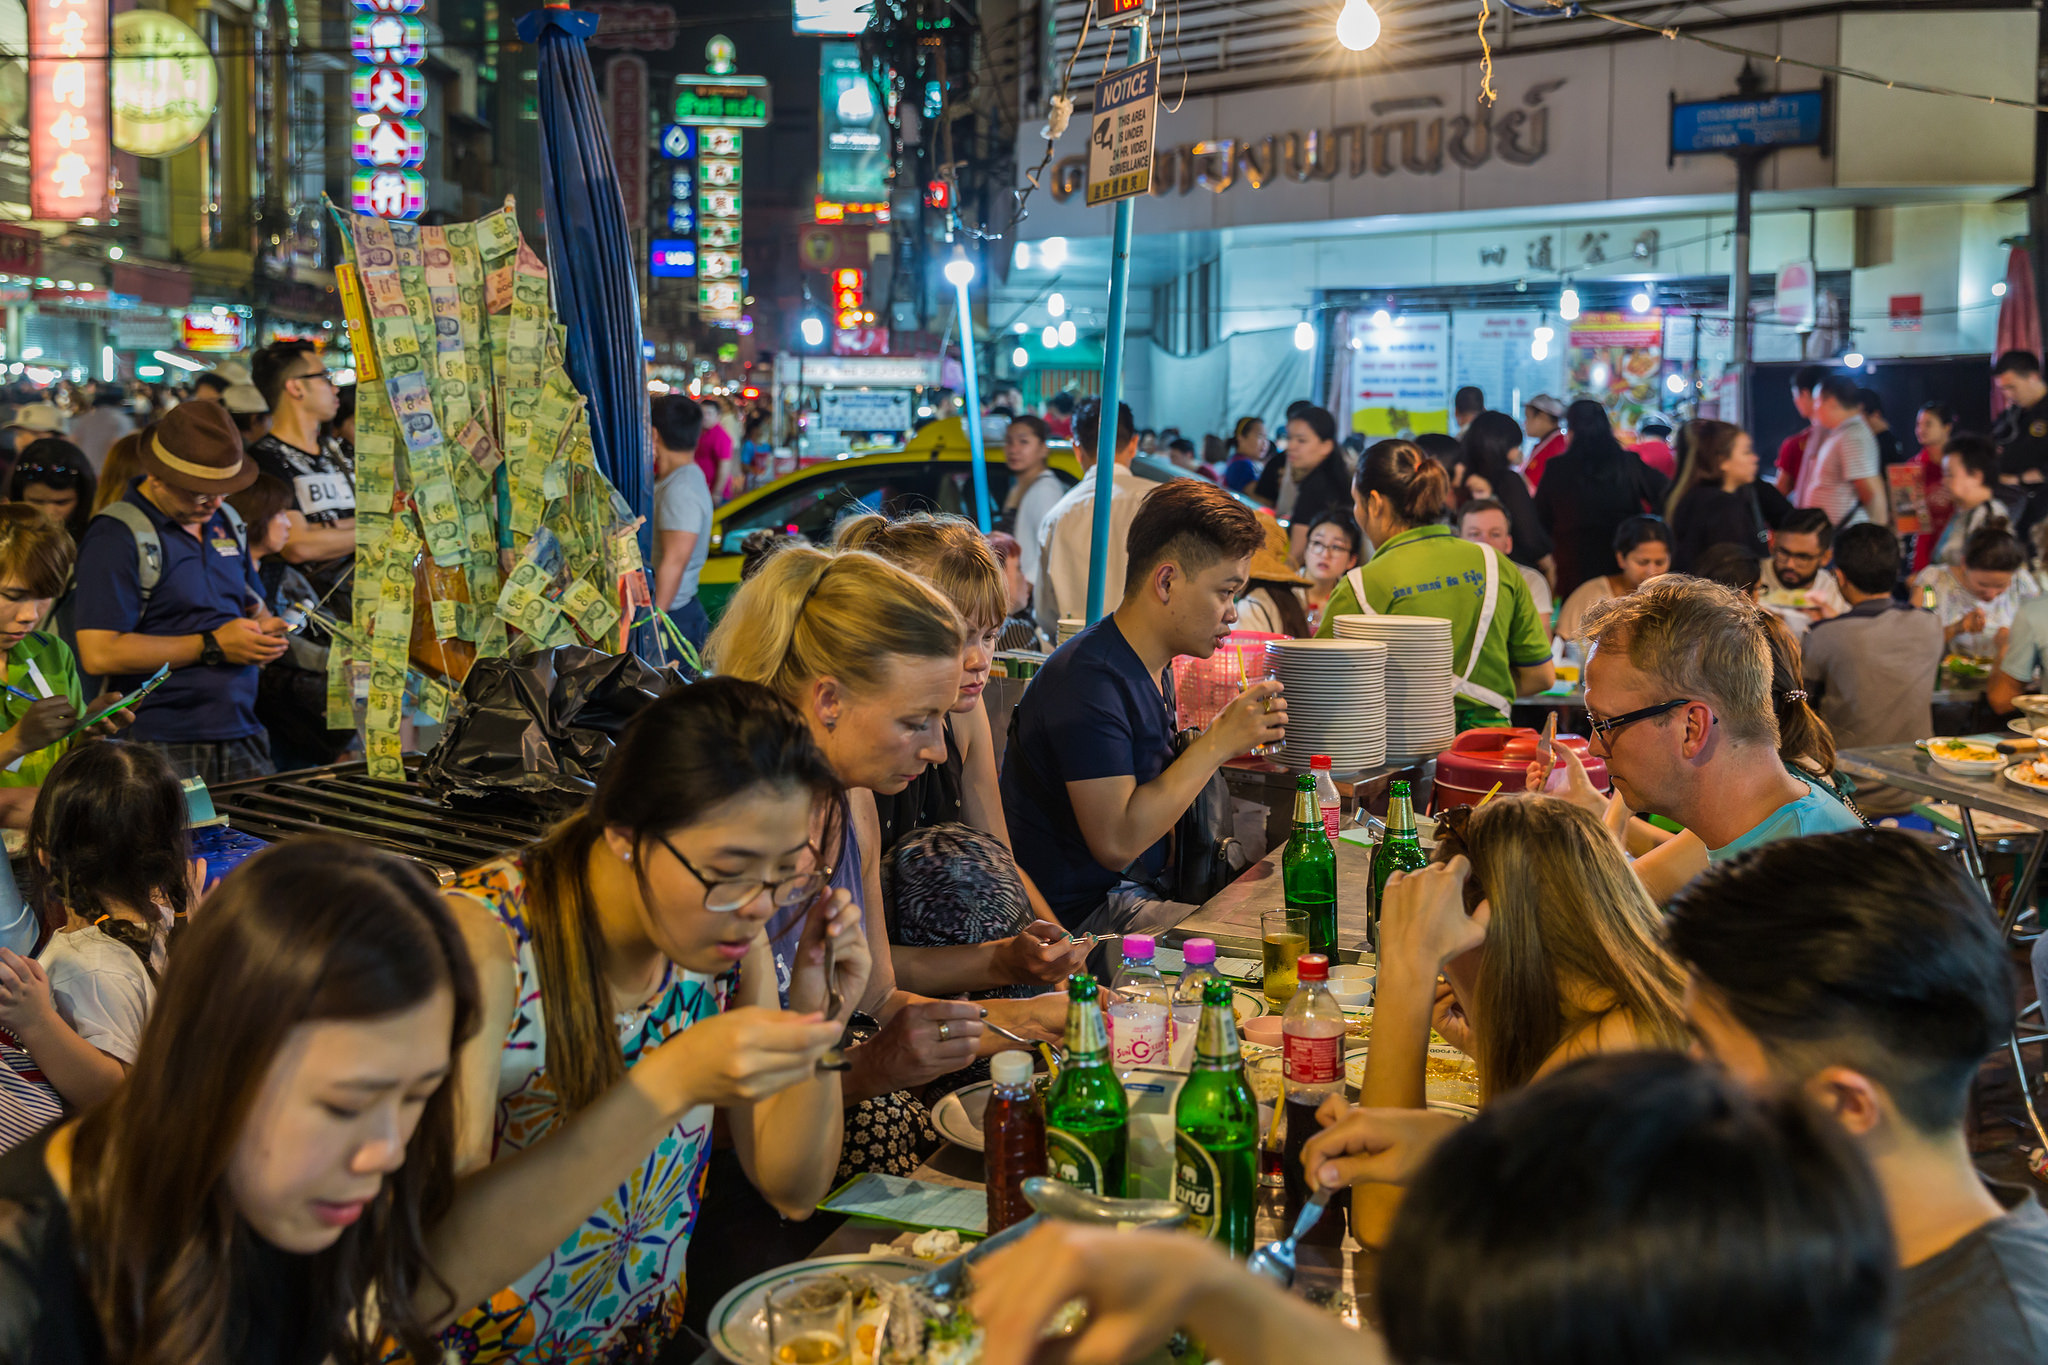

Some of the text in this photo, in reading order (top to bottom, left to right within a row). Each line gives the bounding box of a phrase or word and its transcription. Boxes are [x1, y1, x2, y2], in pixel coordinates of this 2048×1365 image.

[1102, 69, 1149, 108] NOTICE
[1118, 108, 1146, 128] THIS AREA
[1118, 125, 1144, 143] IS UNDER
[1113, 148, 1120, 161] 24
[1131, 140, 1148, 155] VIDEO
[1109, 155, 1149, 177] SURVEILLANCE
